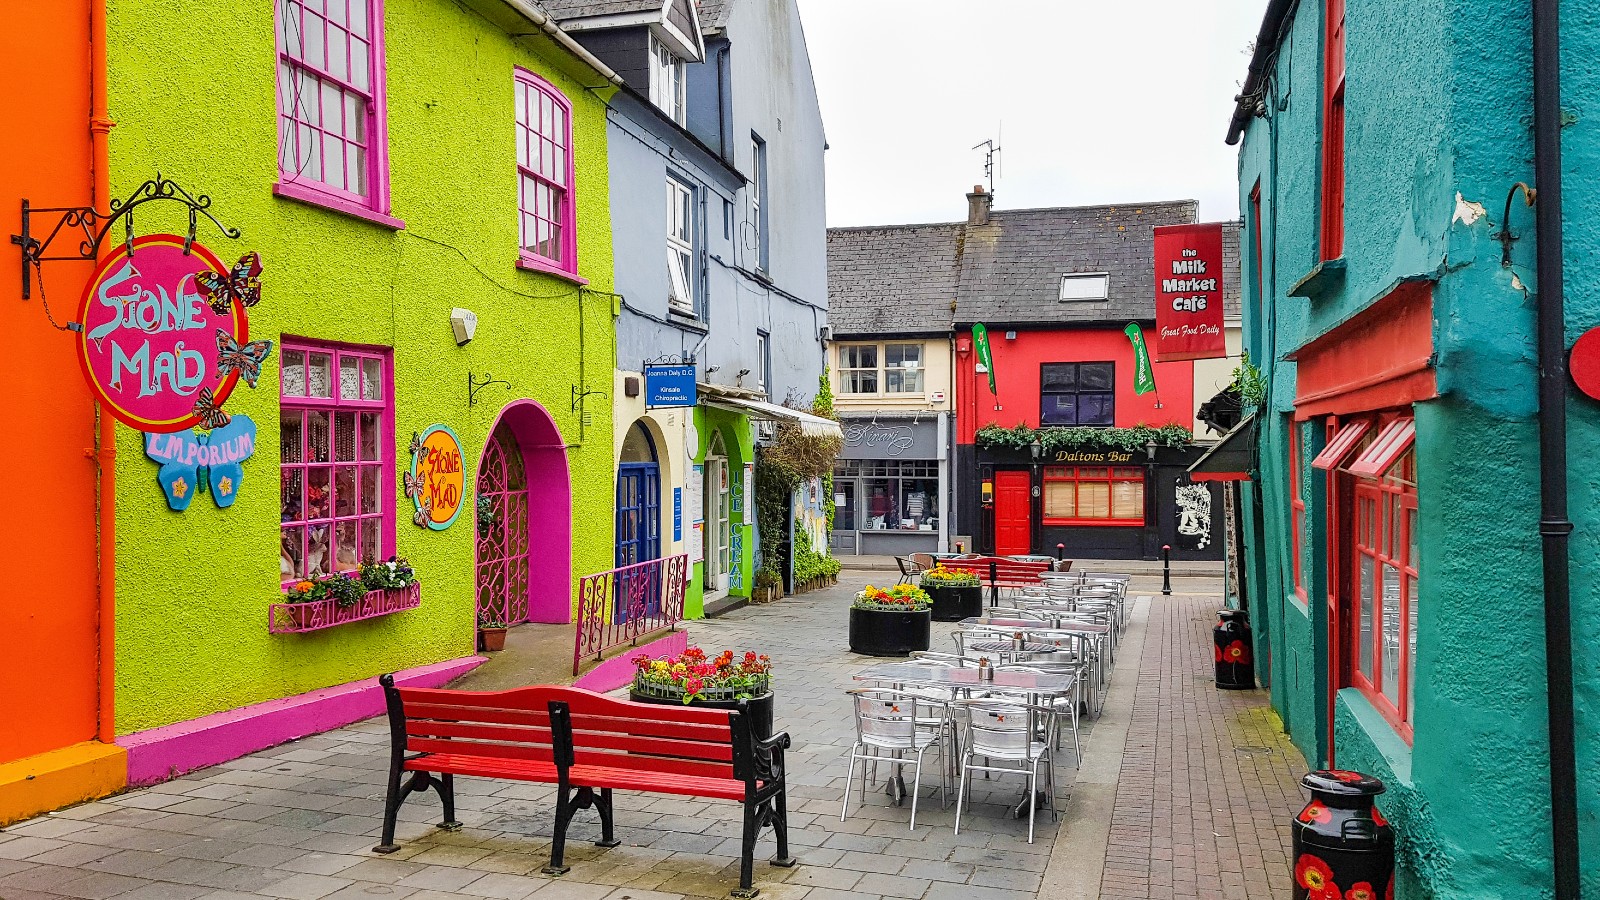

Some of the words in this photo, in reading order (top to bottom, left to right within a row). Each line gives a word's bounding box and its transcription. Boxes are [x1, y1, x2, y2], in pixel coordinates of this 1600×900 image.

[1182, 248, 1197, 257] the
[1172, 260, 1206, 274] Milk
[1162, 279, 1217, 293] Market
[87, 260, 207, 353] STONE
[1172, 295, 1207, 311] Café
[1161, 326, 1180, 340] Great
[1181, 324, 1198, 337] Food
[1199, 323, 1220, 336] Daily
[109, 339, 206, 399] MAD
[147, 432, 255, 467] EMPORIUM
[1055, 450, 1105, 462] Daltons
[1107, 450, 1133, 462] Bar
[429, 476, 457, 511] MAD
[731, 471, 743, 513] ICE
[729, 523, 744, 589] CREAM
